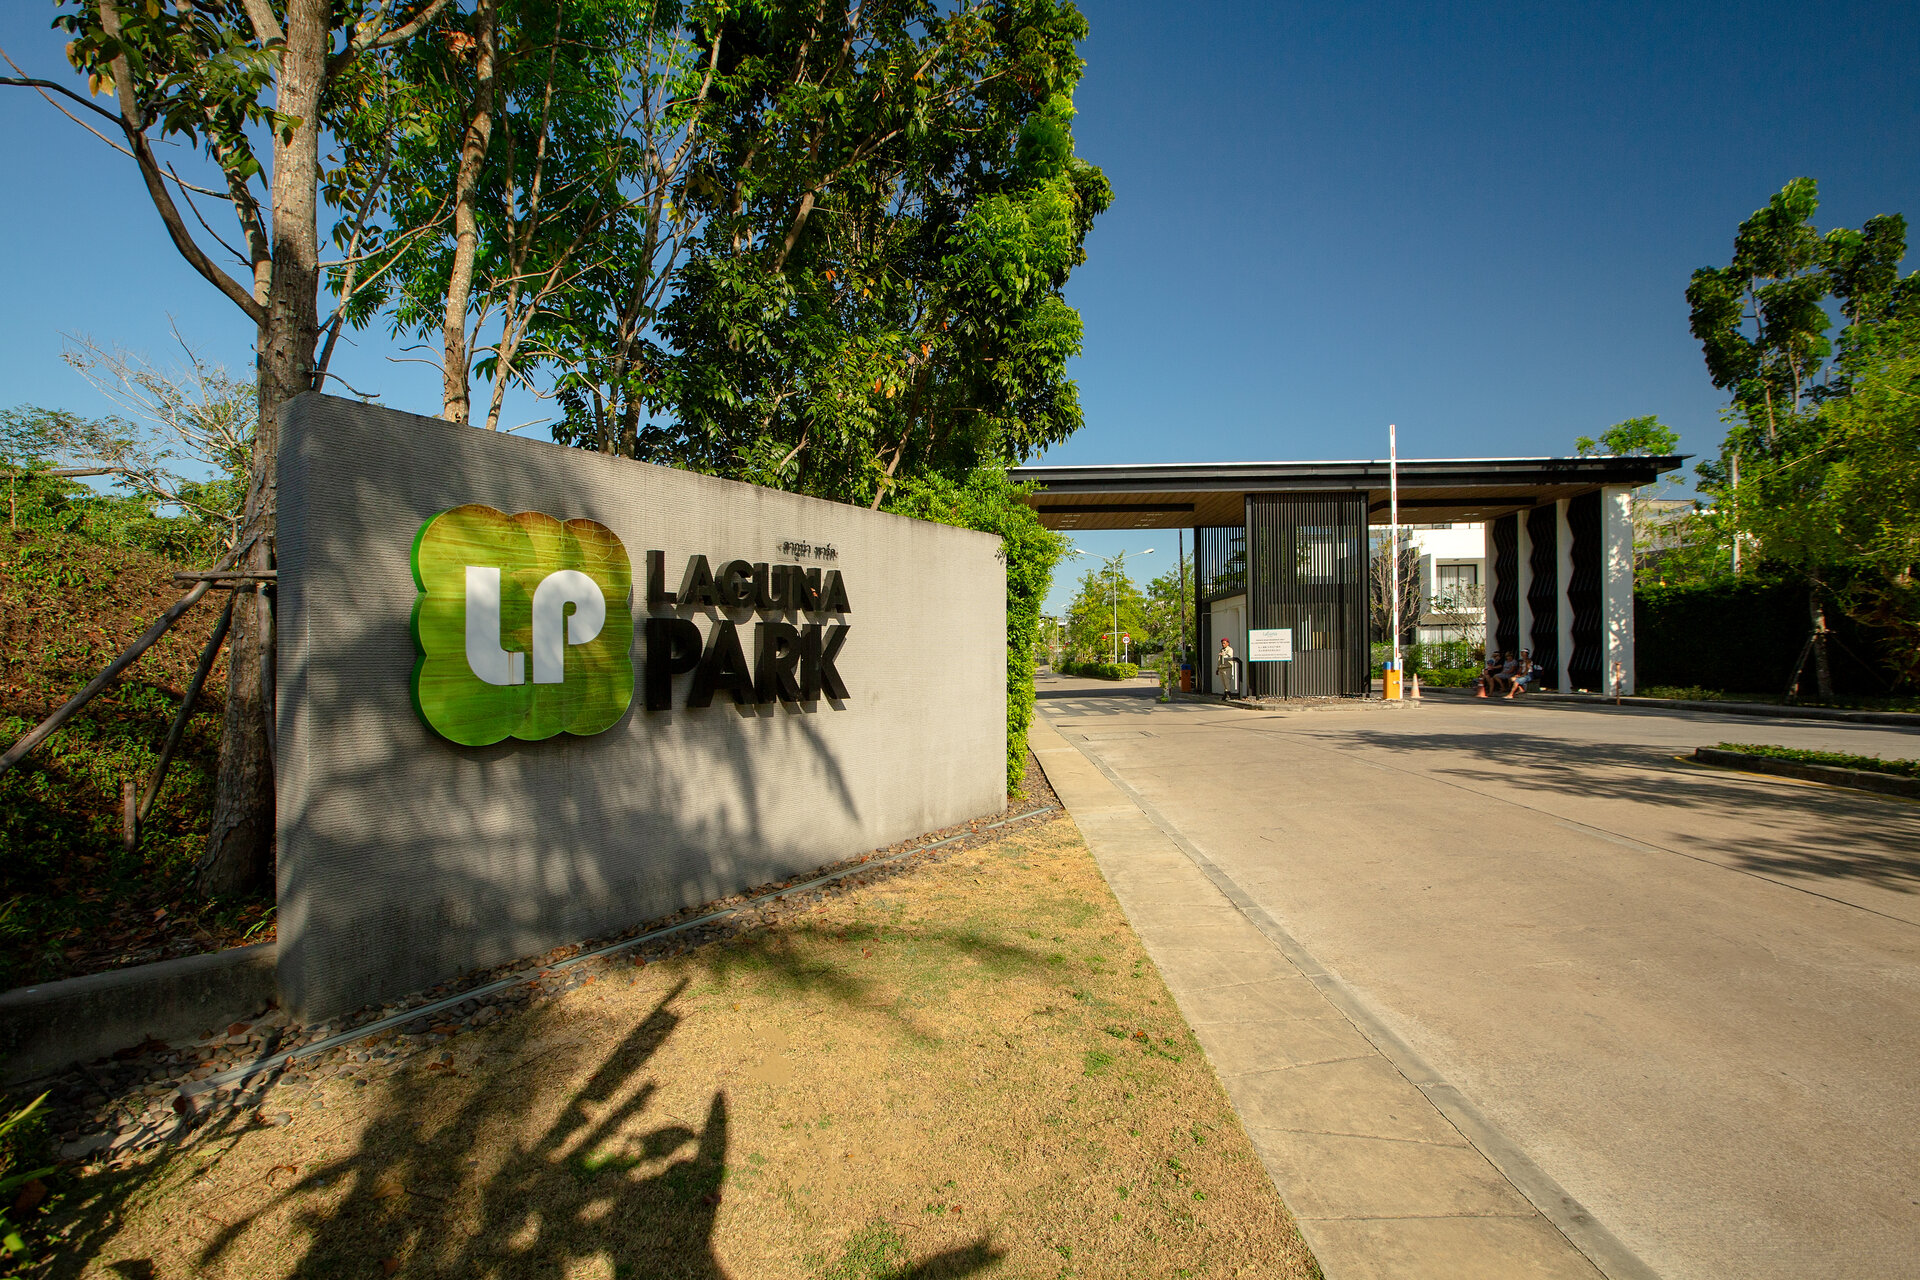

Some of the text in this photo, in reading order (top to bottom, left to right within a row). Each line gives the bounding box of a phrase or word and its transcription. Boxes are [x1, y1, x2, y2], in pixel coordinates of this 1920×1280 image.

[465, 566, 606, 685] LP
[646, 550, 851, 614] LAGUNA
[646, 618, 851, 711] PARK
